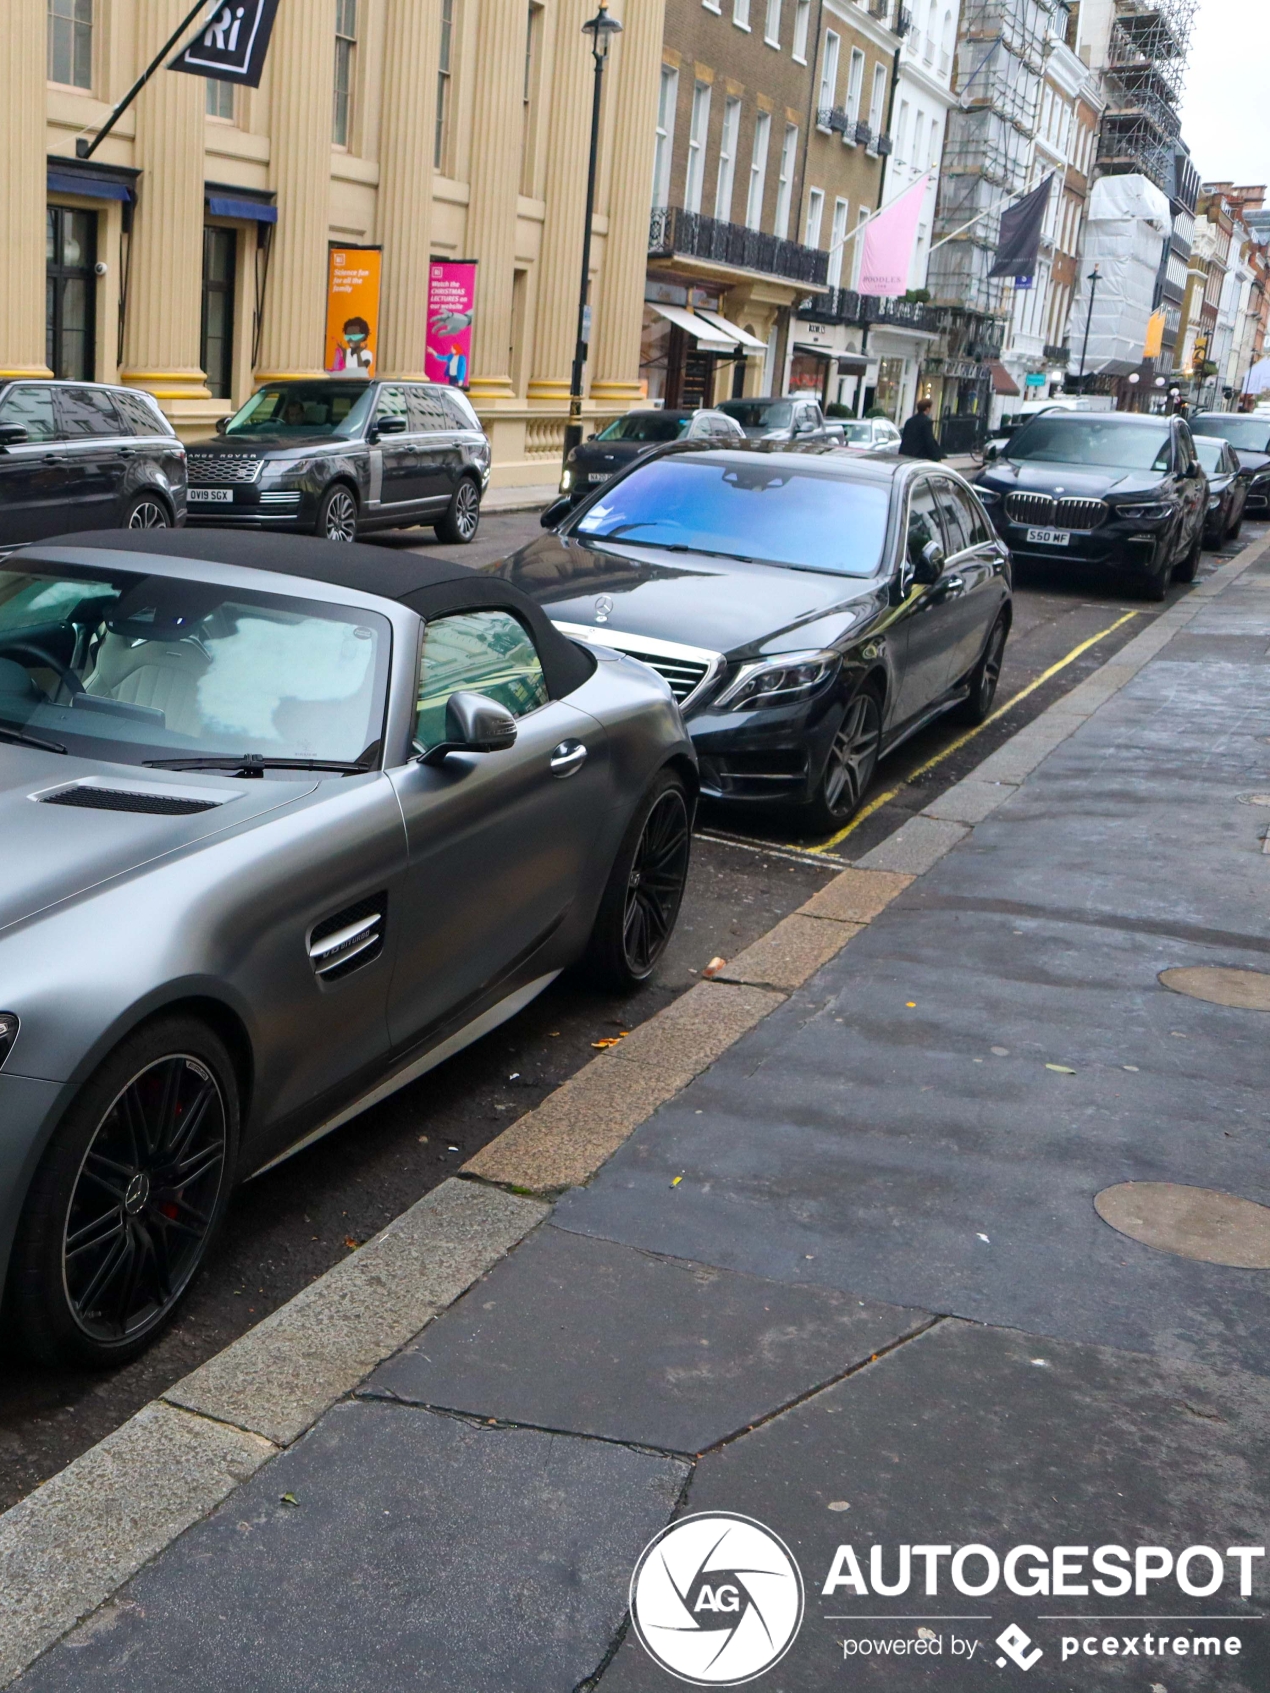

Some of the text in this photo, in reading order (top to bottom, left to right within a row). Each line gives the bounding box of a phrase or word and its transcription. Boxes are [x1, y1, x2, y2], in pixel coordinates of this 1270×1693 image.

[332, 284, 353, 293] family
[190, 490, 228, 500] OV19 SGX
[1030, 531, 1050, 542] S50
[340, 929, 370, 950] BITURBO
